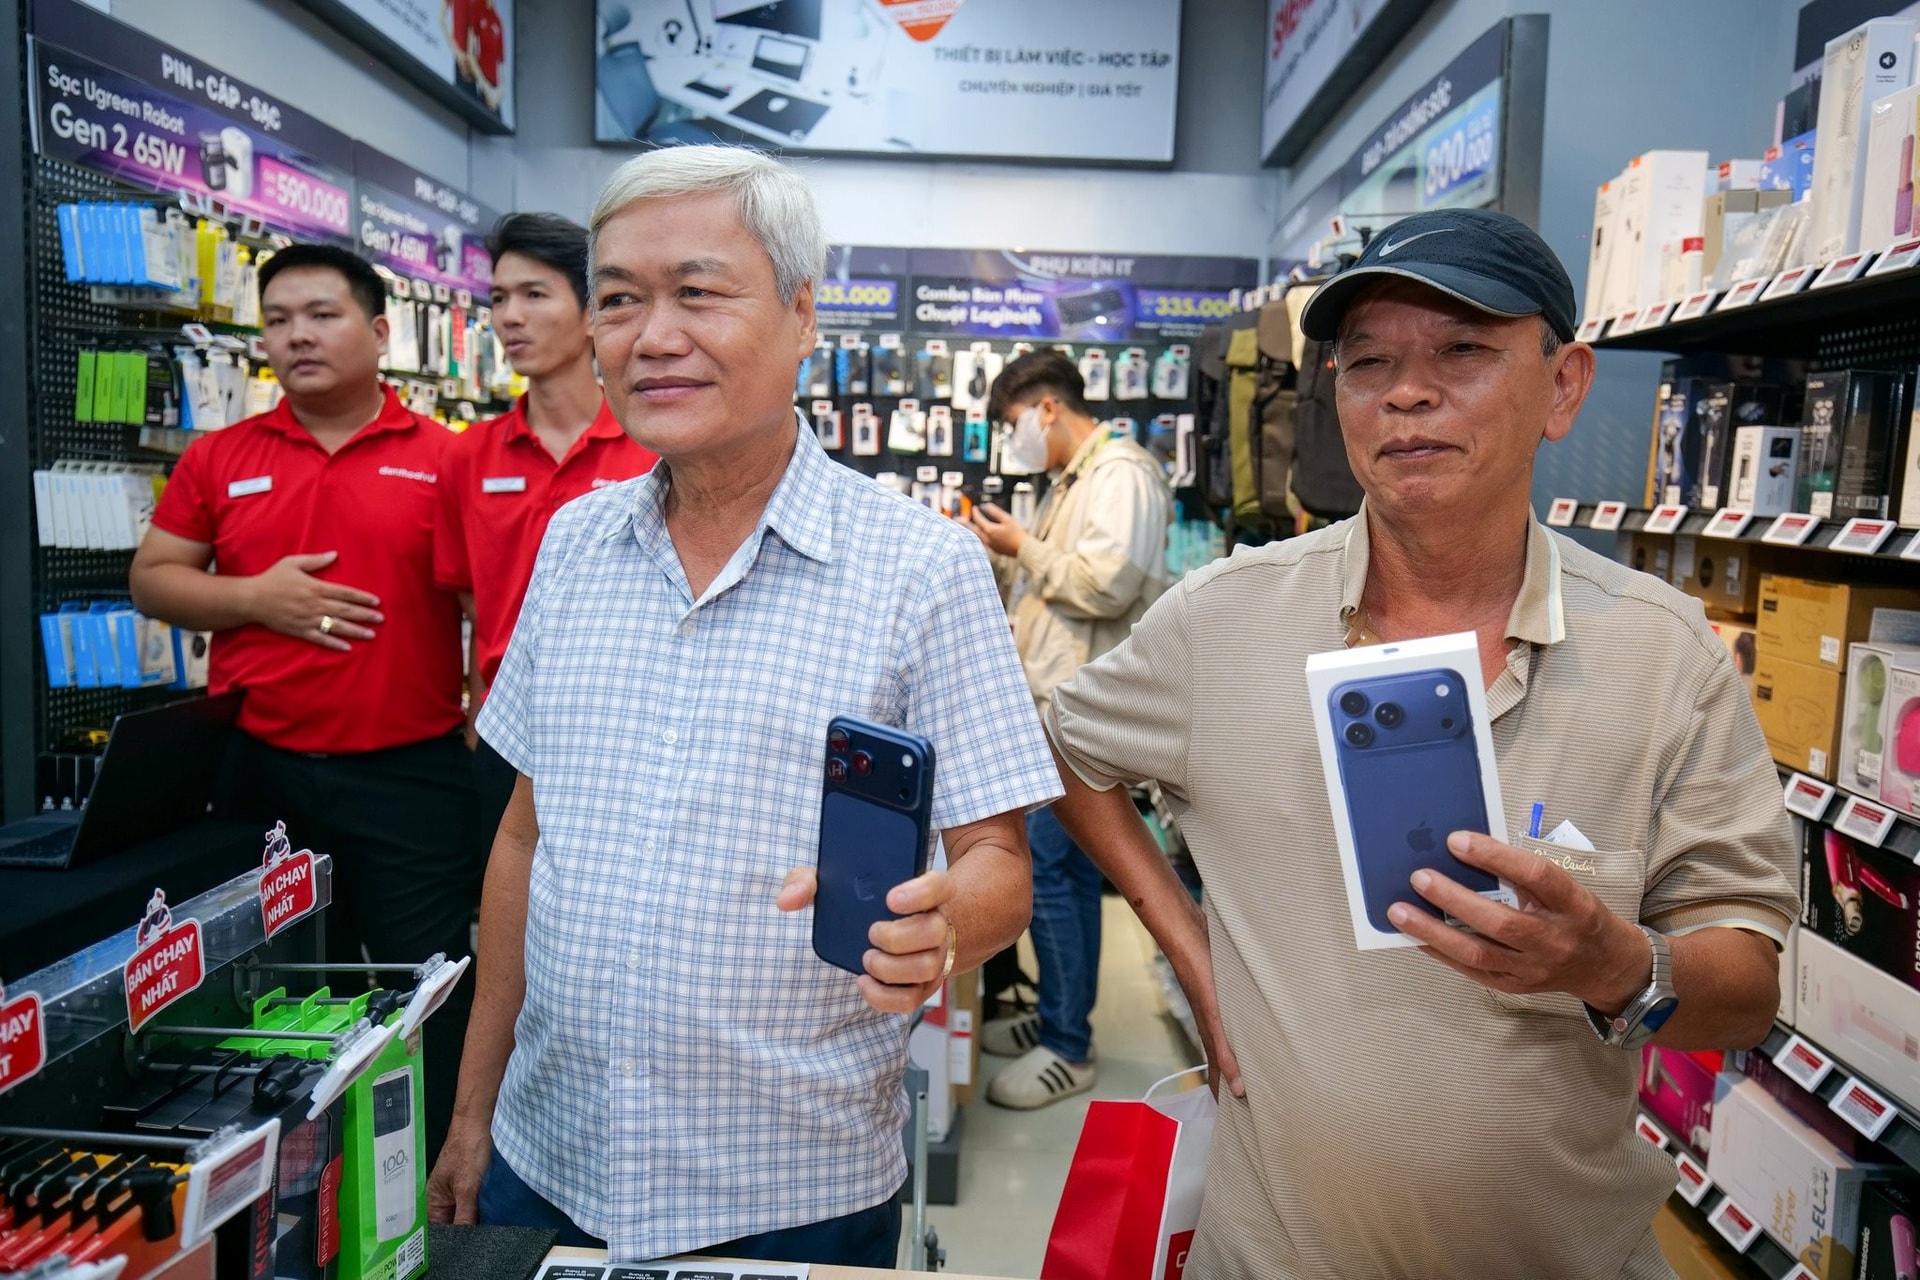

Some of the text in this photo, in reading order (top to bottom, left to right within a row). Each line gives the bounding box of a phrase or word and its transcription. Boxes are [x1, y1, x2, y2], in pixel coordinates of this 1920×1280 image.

[48, 64, 185, 135] Sạc Ugreen Robot
[161, 52, 195, 91] PIN
[205, 74, 241, 110] CÁP
[250, 95, 282, 131] SẠC
[50, 102, 186, 177] Gen 2 65W
[276, 170, 348, 228] 590.000
[261, 862, 309, 905] ÁN CHẠY
[267, 893, 294, 926] NHẤT
[128, 933, 195, 994] BÁN CHẠY
[141, 969, 179, 1012] NHẤT
[0, 1009, 35, 1044] HẠY
[1771, 1192, 1785, 1234] Hair
[1782, 1185, 1797, 1244] Dryer
